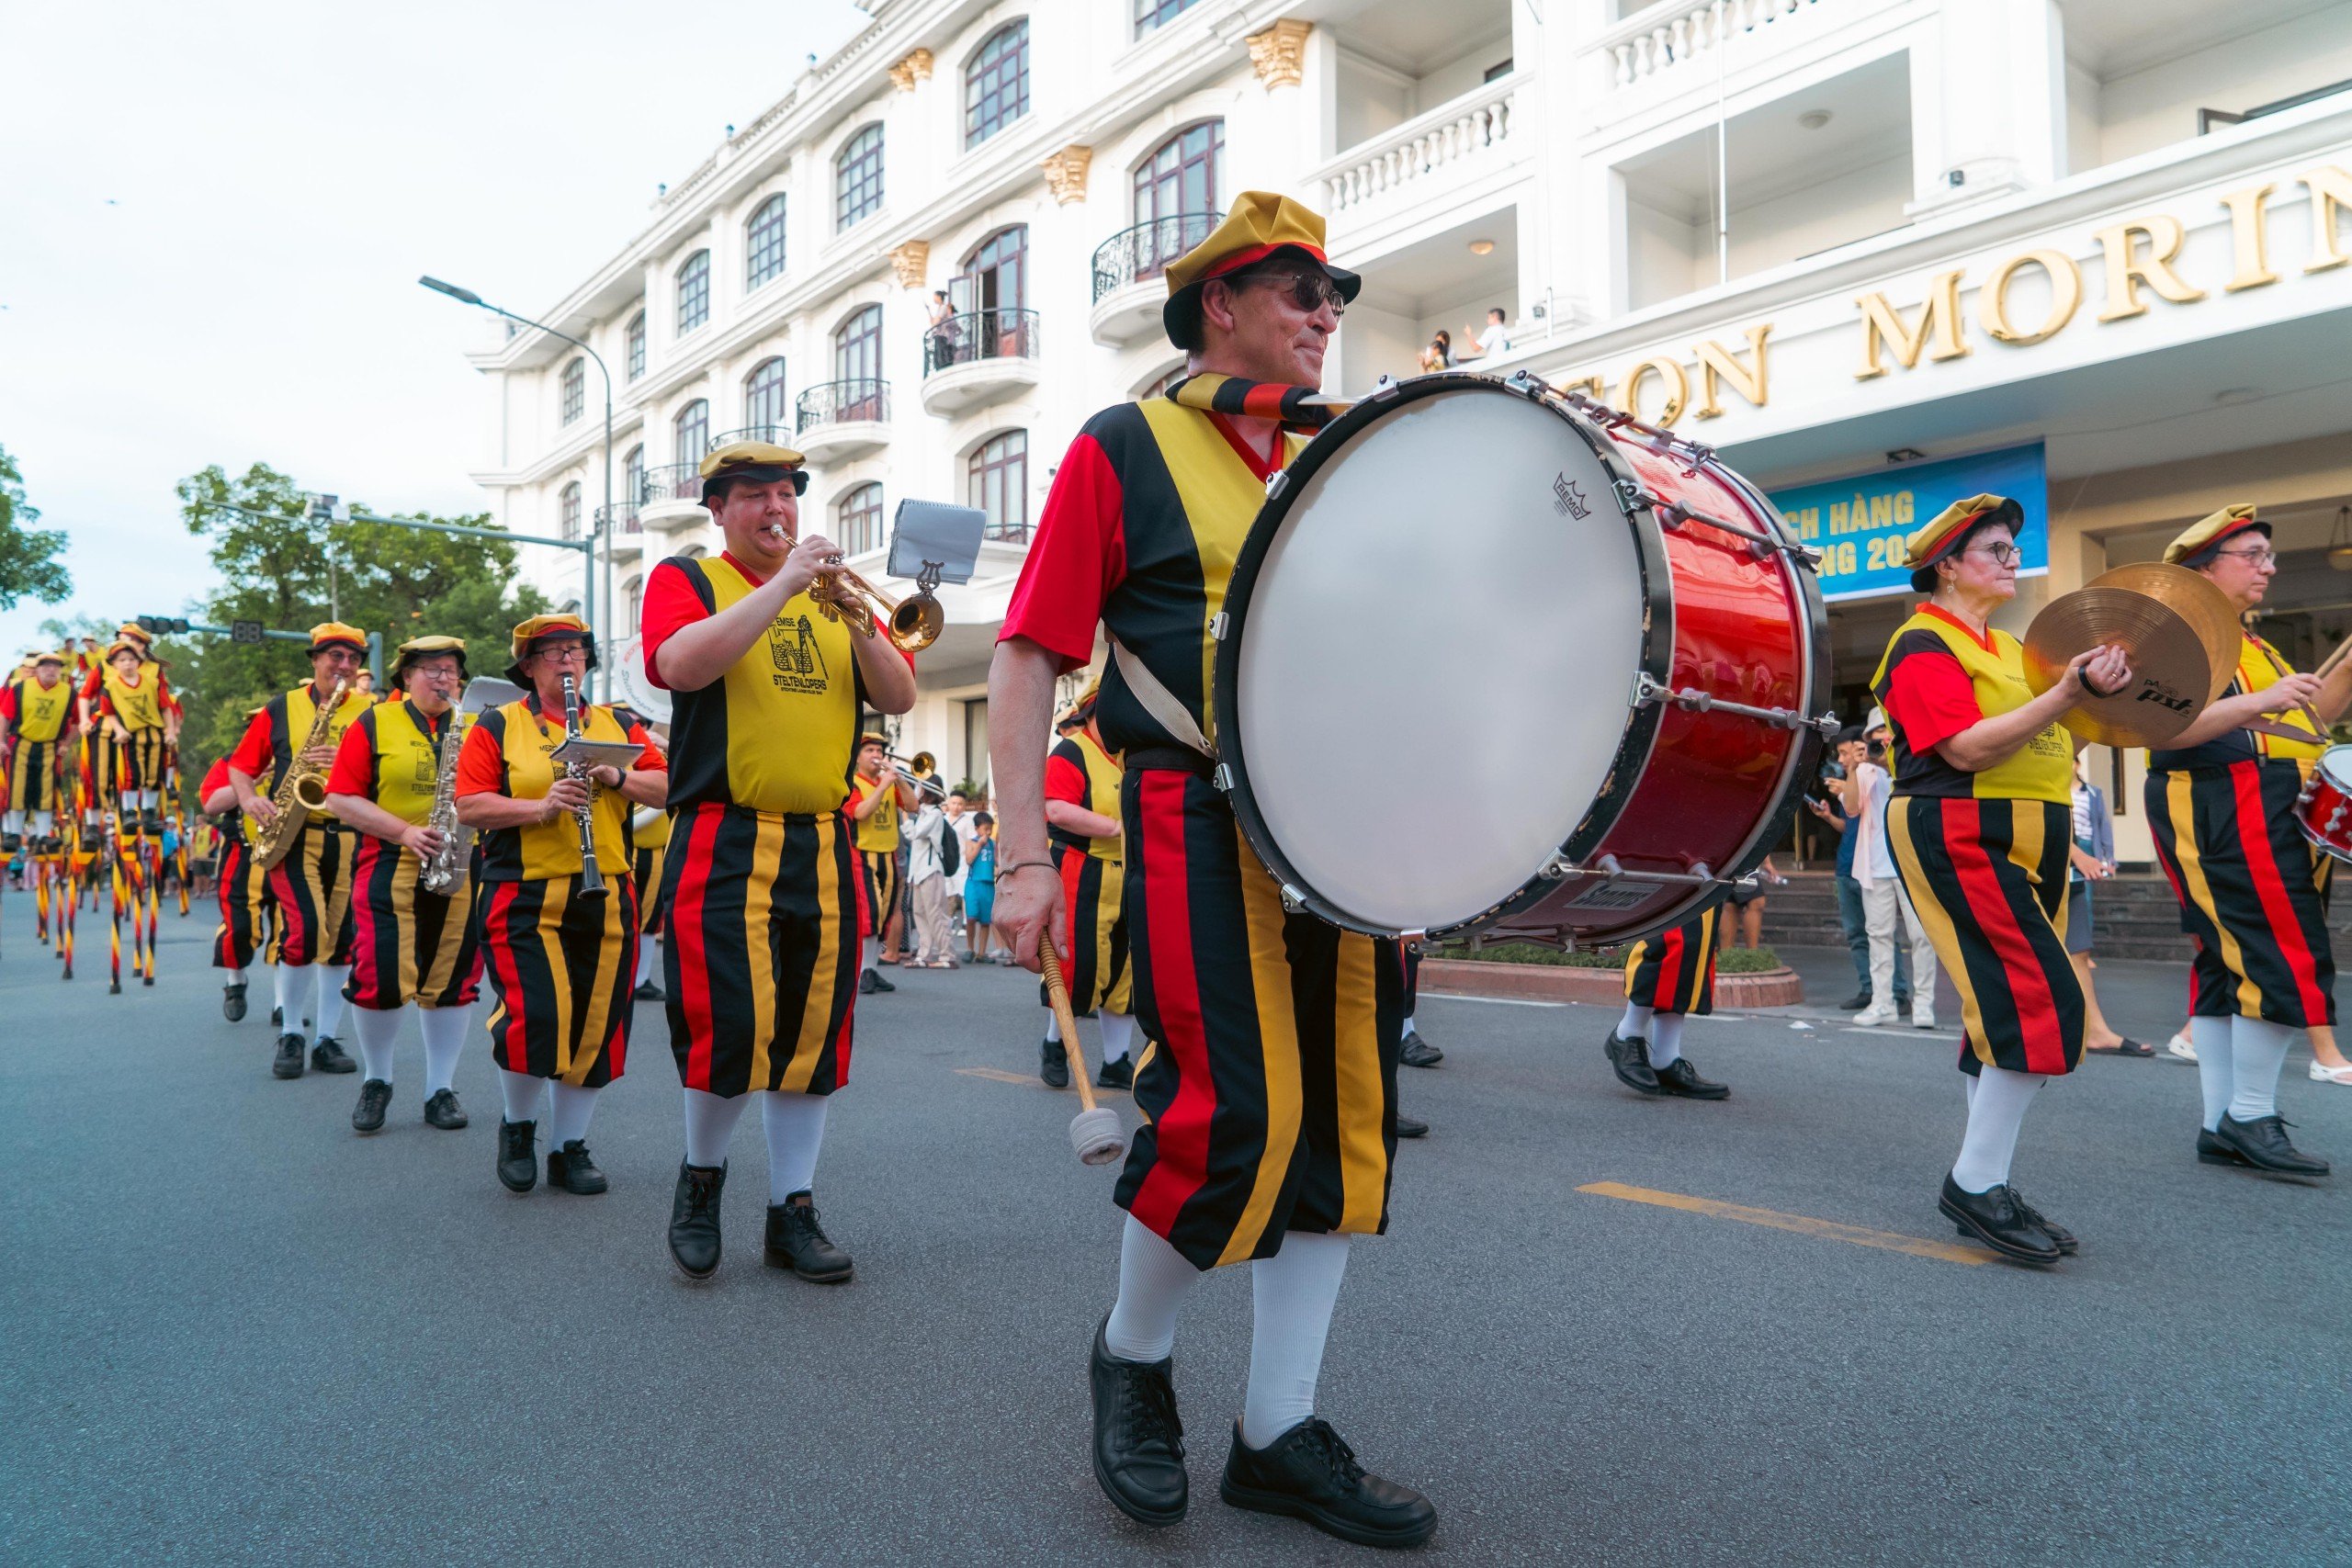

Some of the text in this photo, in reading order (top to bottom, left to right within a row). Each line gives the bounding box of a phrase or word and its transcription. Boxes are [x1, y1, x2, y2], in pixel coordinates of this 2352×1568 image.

[1556, 483, 1581, 516] REMO
[1782, 490, 1915, 540] CH HÀNG
[1815, 541, 1857, 579] NG
[773, 674, 827, 691] STELTENLOPERS
